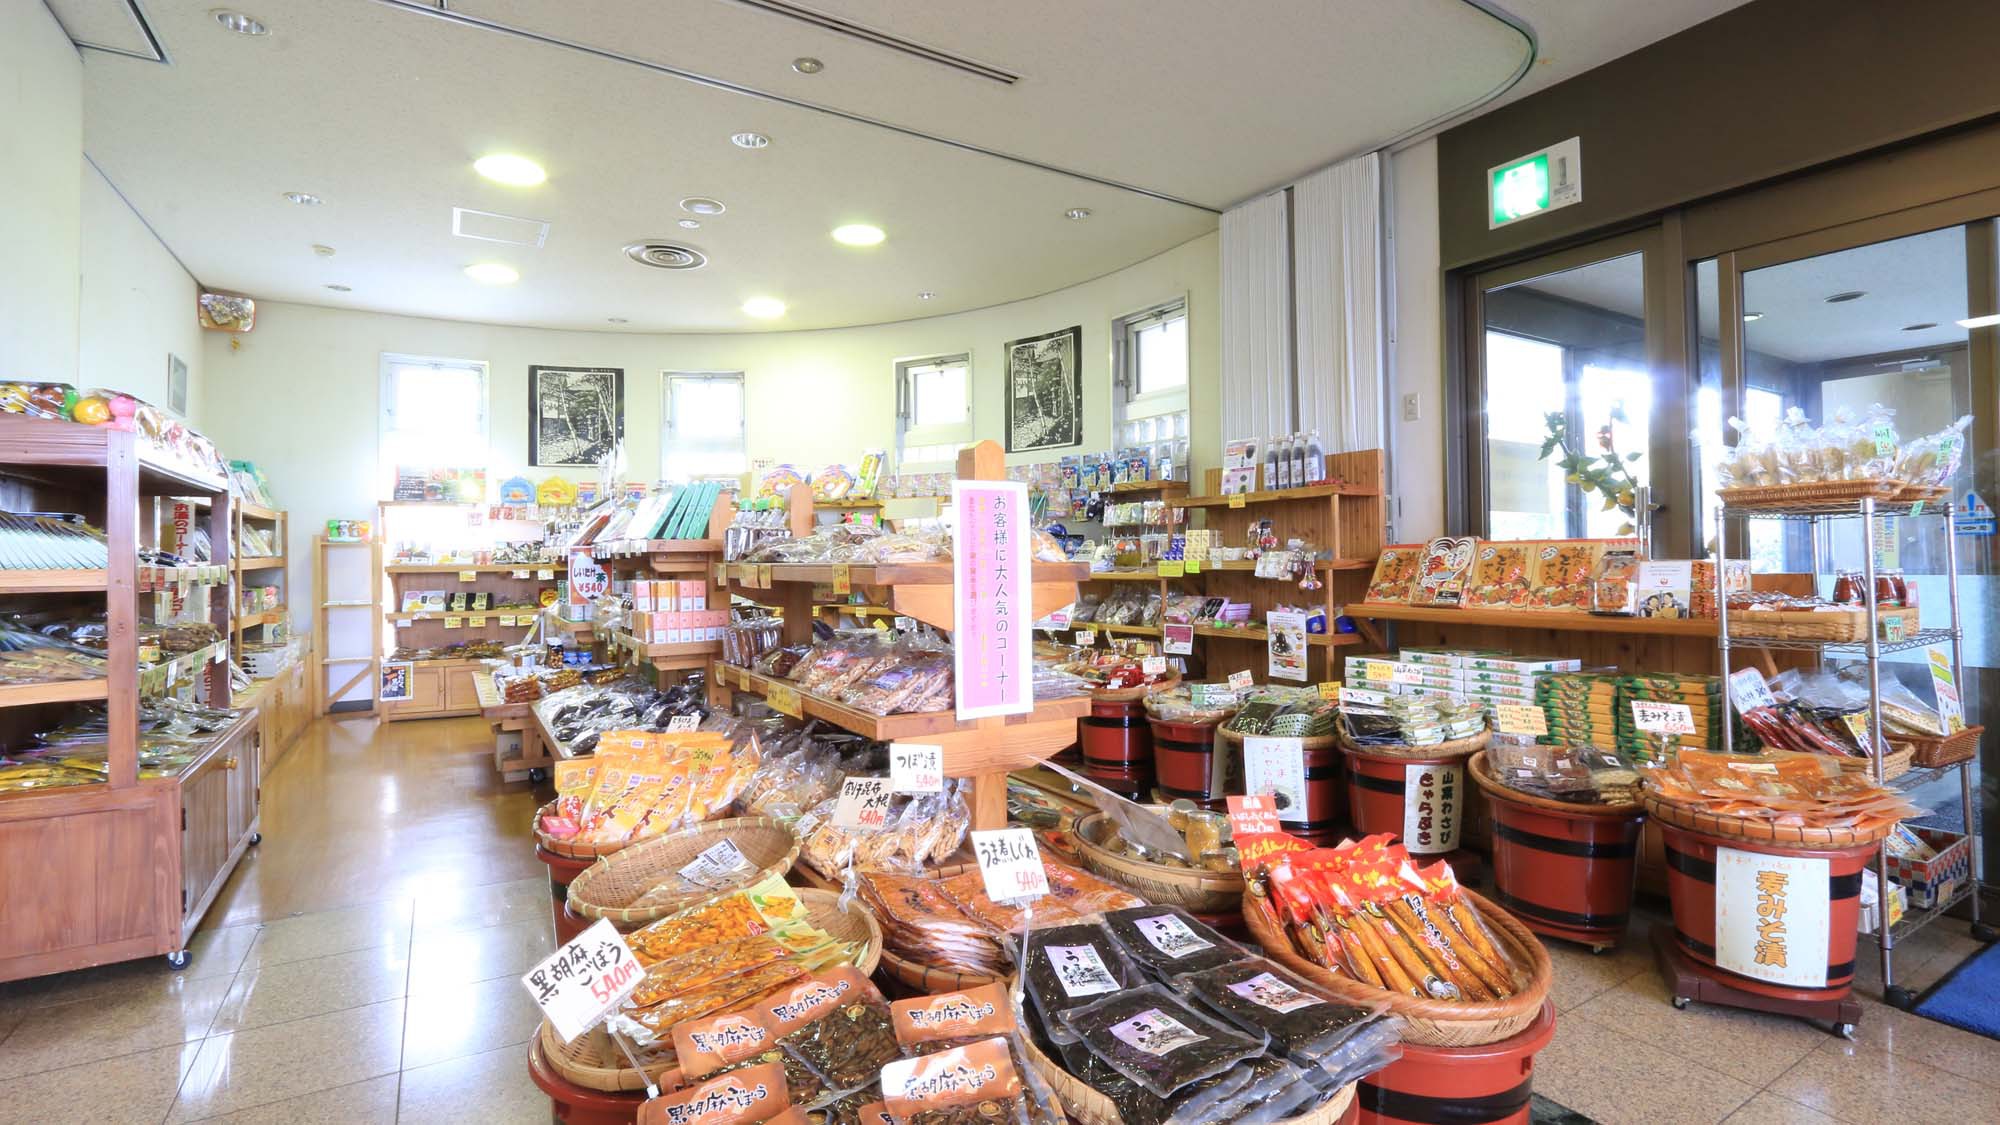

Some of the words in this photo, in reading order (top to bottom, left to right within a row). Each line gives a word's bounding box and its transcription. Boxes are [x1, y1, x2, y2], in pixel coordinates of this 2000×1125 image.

[993, 495, 1009, 703] お客様に大人気のコーナー
[1638, 709, 1686, 723] 麦みそ漬
[897, 752, 937, 771] つぼ漬
[915, 774, 941, 788] 540円
[857, 810, 885, 825] 540円
[1417, 772, 1434, 845] きゃらぶき
[1440, 771, 1455, 844] 山菜わさび
[1015, 871, 1045, 891] 540円
[1753, 870, 1789, 969] 麦みそ漬
[530, 943, 587, 1005] 黒胡麻
[578, 941, 622, 987] ごぼう
[591, 959, 638, 1005] 540円
[771, 980, 850, 1024] 黒胡麻ごぼう
[908, 1002, 995, 1028] 黒胡麻ごぼう
[690, 1025, 766, 1054] 黒胡麻ごぼ
[904, 1065, 996, 1100] 黒胡麻ごぼう
[666, 1085, 768, 1124] 黒胡麻ごぼう
